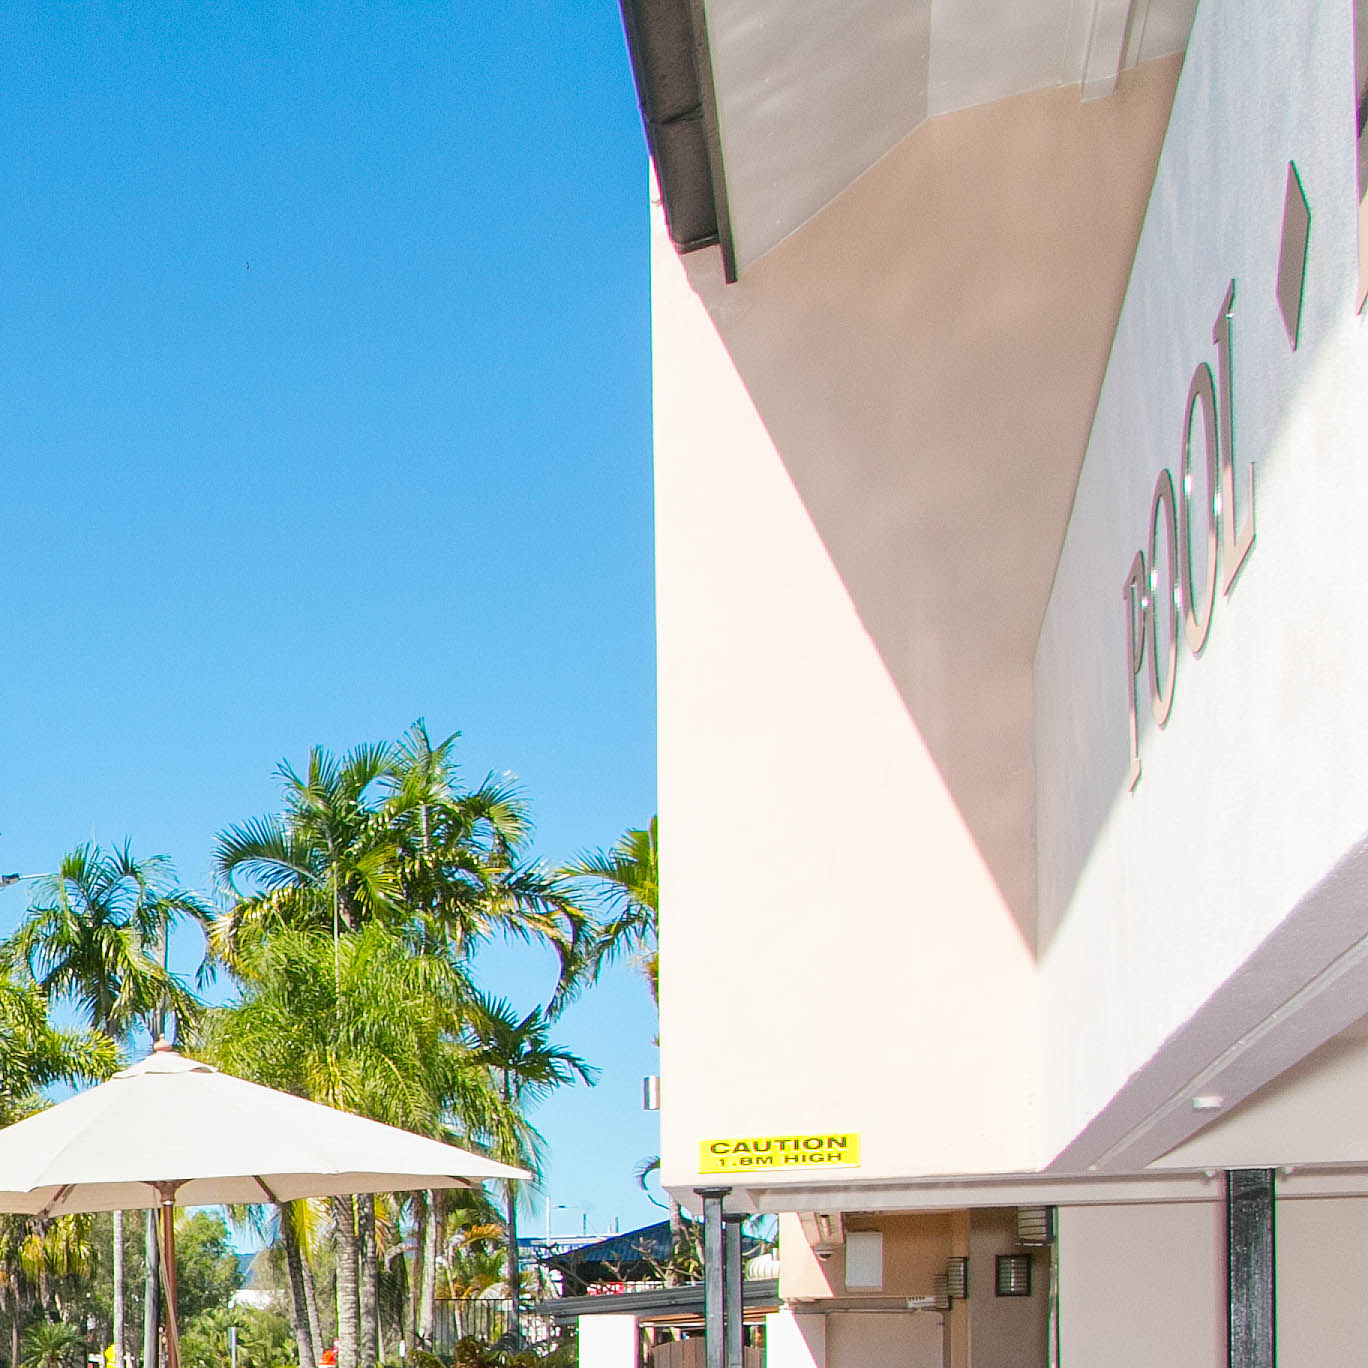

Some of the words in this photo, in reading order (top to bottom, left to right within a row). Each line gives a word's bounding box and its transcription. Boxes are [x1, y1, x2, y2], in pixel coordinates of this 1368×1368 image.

[1122, 279, 1256, 793] POOL
[710, 1136, 848, 1154] CAUTION
[718, 1156, 773, 1167] 1.8M
[784, 1152, 843, 1164] HIGH
